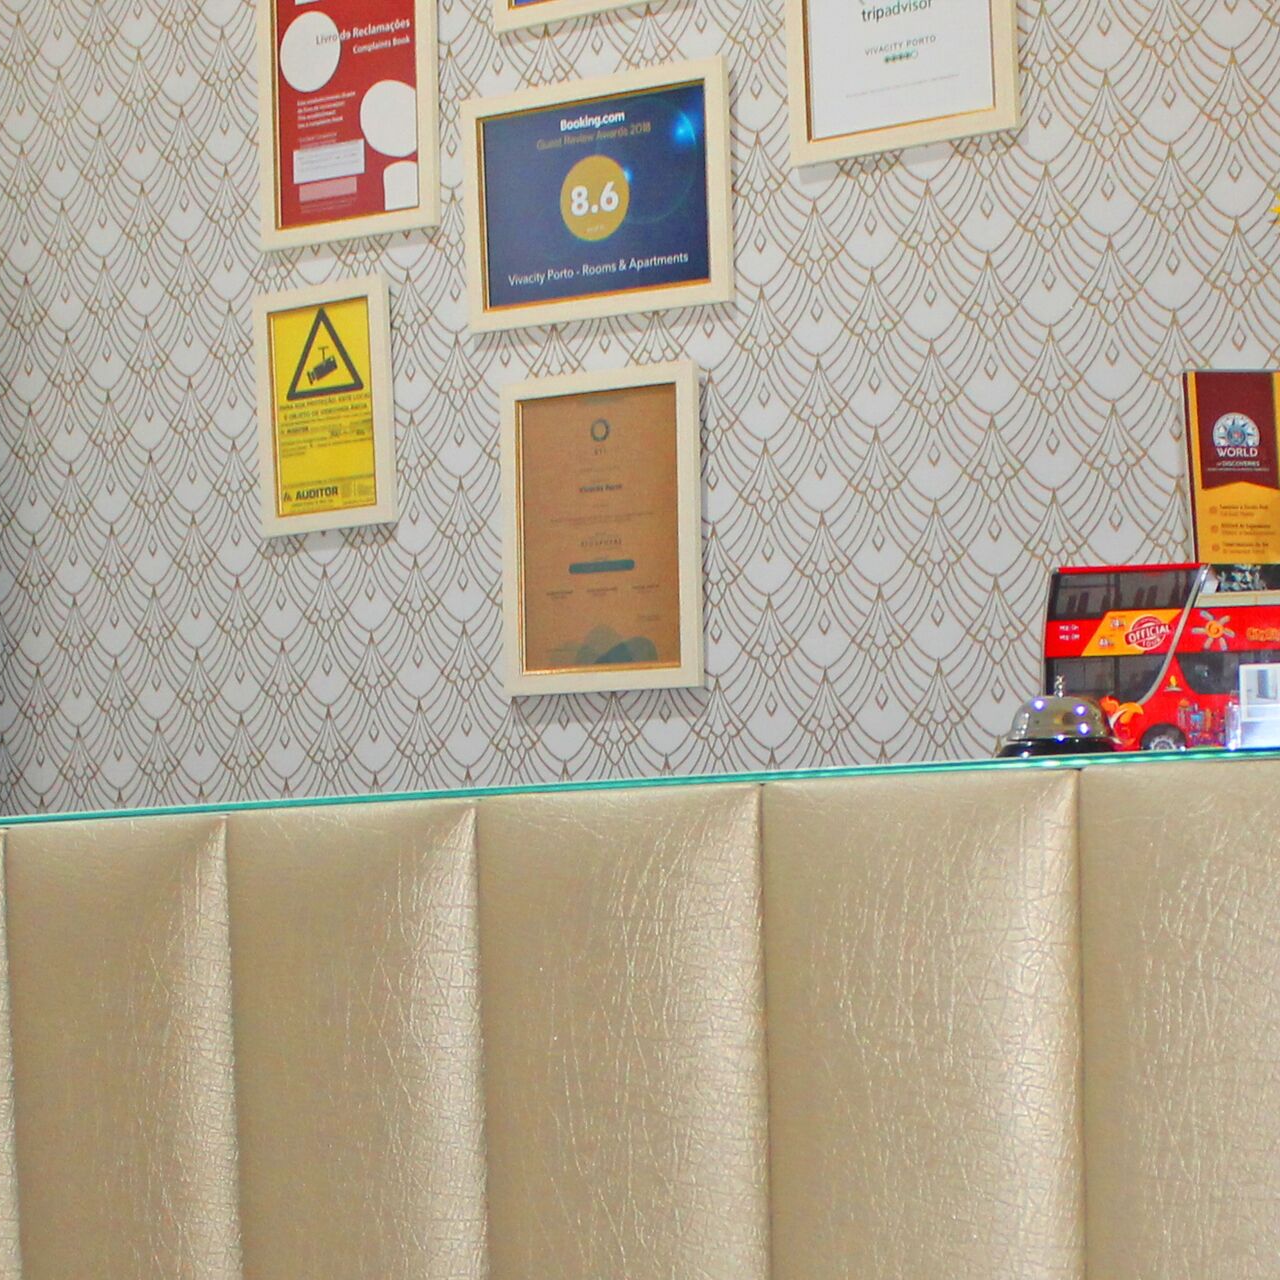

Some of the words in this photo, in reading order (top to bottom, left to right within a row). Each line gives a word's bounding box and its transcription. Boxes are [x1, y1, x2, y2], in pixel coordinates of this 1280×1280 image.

[861, 0, 933, 22] tripadvisor
[352, 18, 410, 39] Reclamações
[864, 40, 904, 56] VIVACITY
[906, 35, 937, 47] PORTO
[559, 110, 626, 132] Booking.com
[536, 137, 563, 151] Guest
[563, 132, 595, 145] Review
[596, 126, 629, 140] Awards
[630, 121, 652, 136] 2018
[570, 181, 620, 217] 8.6
[508, 270, 546, 286] Vivacity
[547, 267, 575, 281] Porto
[582, 261, 617, 275] Rooms
[618, 258, 628, 271] &
[628, 251, 690, 271] Apartments
[1216, 446, 1259, 458] WORLD
[295, 486, 338, 500] AUDITOR
[1128, 624, 1170, 643] OFFICIAL
